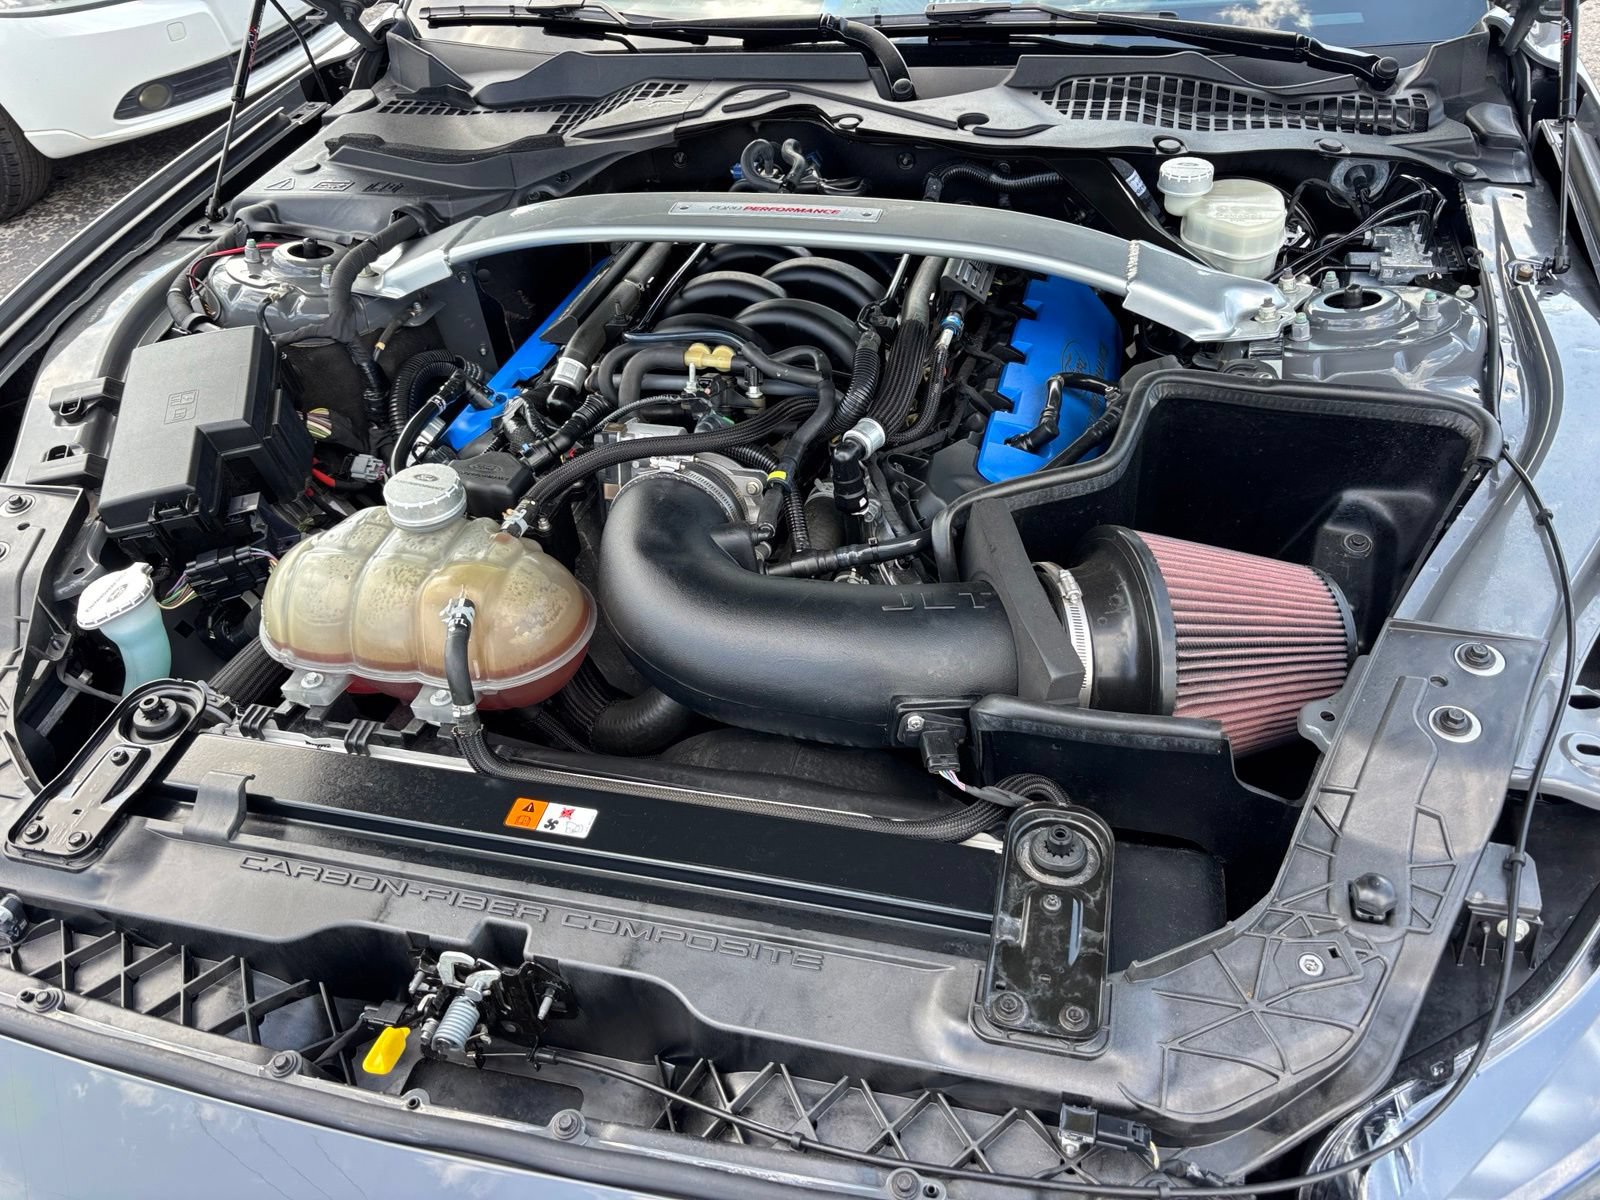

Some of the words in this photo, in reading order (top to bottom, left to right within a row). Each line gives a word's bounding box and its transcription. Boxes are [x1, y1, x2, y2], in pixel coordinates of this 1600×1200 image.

[742, 204, 841, 215] PERFORMANCE
[239, 855, 548, 922] CARBON-FIBER
[561, 912, 825, 971] COMPOSITE
